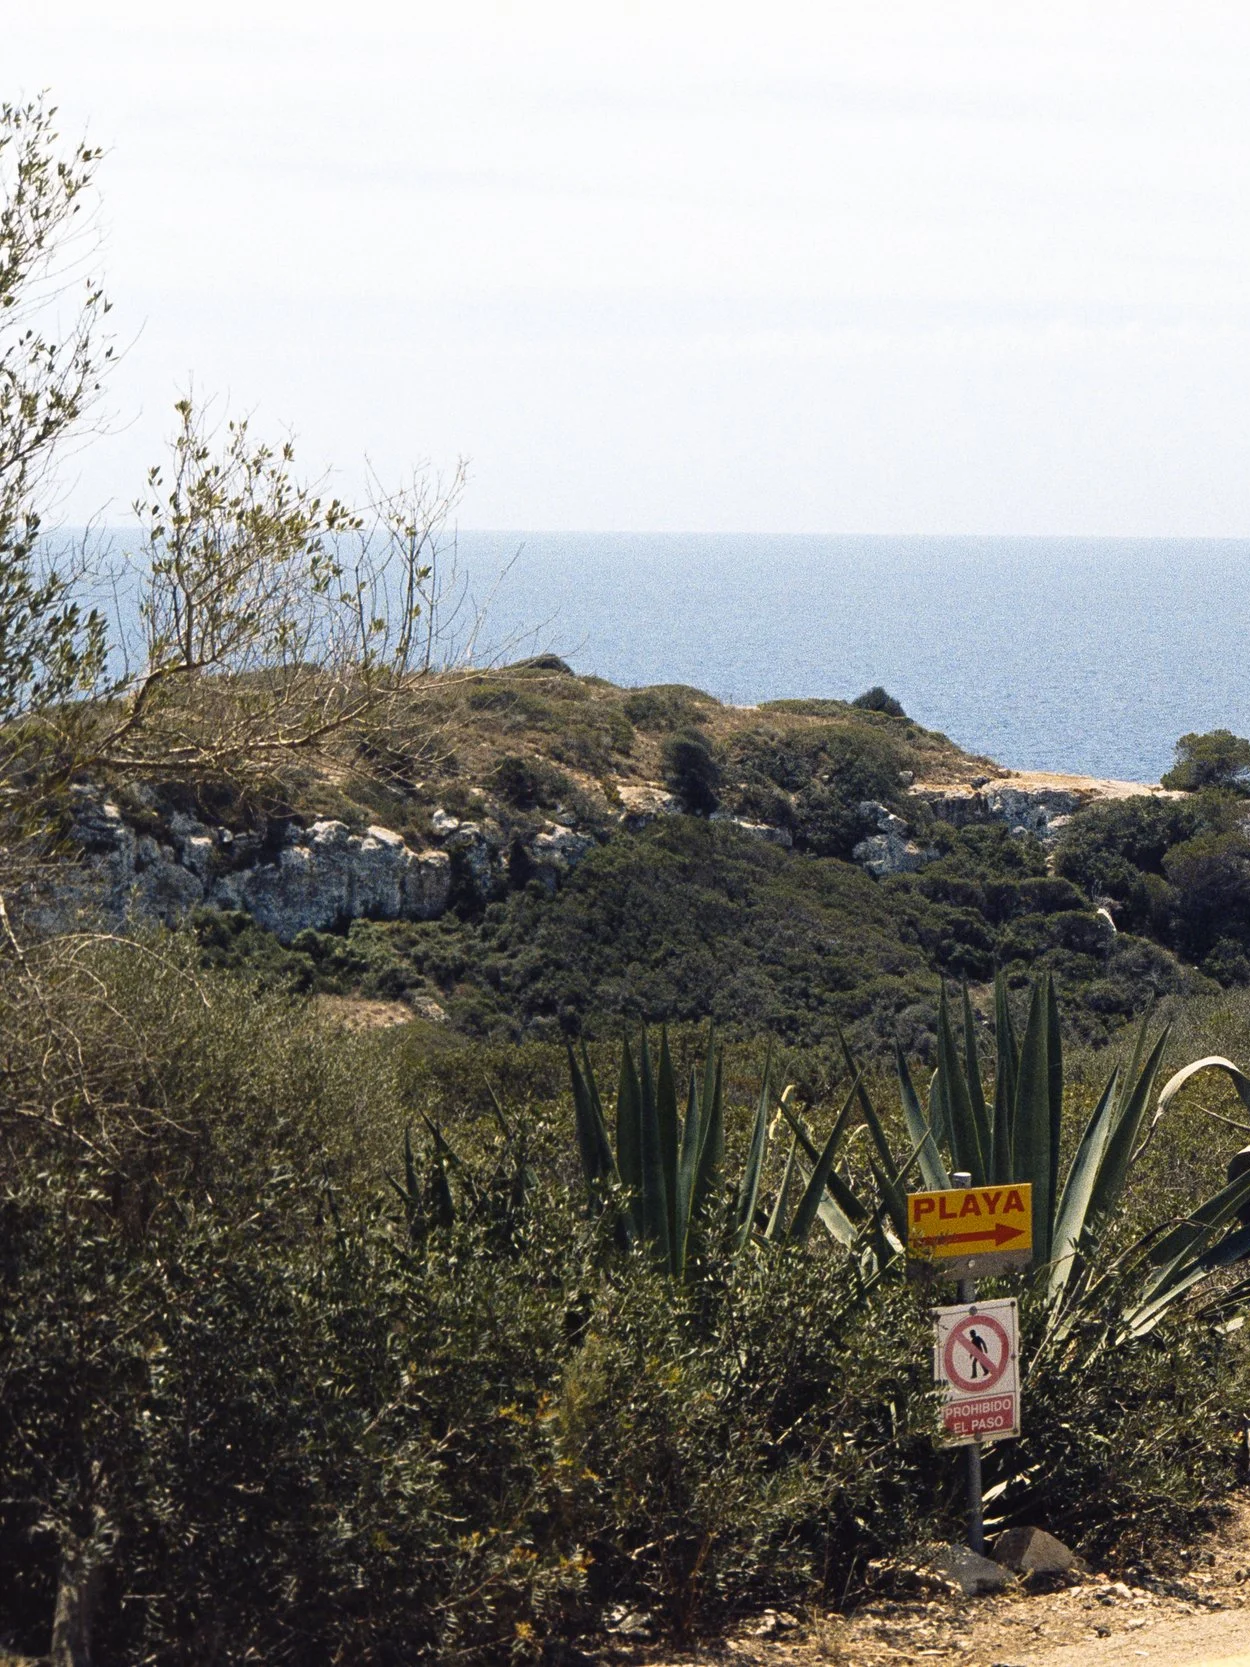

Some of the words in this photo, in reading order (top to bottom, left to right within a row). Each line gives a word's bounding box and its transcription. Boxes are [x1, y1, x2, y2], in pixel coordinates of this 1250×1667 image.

[913, 1190, 1025, 1222] PLAYA
[945, 1399, 1012, 1418] PROHIBIDO
[953, 1422, 968, 1434] EL
[971, 1415, 1004, 1431] PASO
